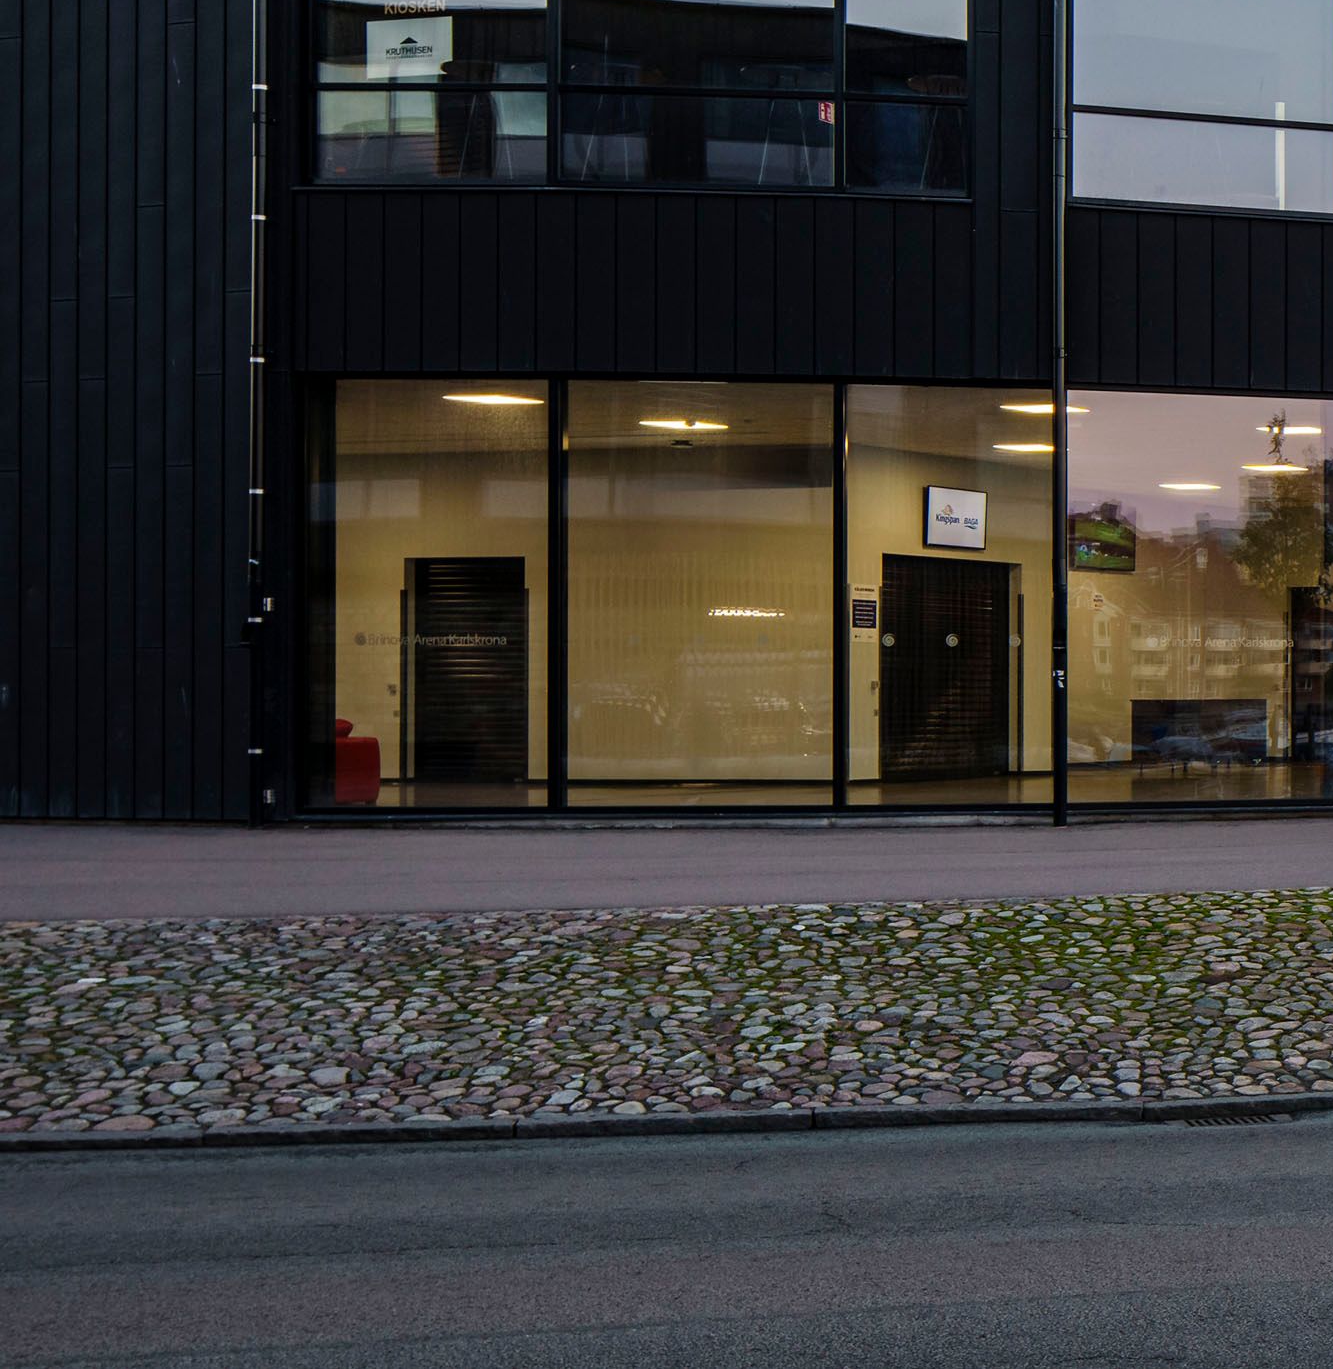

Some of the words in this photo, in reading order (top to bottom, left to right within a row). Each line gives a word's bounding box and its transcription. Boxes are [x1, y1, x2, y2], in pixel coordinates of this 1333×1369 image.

[384, 0, 447, 15] KIOSKEN
[414, 633, 446, 646] Arena
[449, 633, 507, 646] Karlskrona
[1204, 636, 1237, 648] Arena
[1239, 636, 1294, 648] Karlskrona
